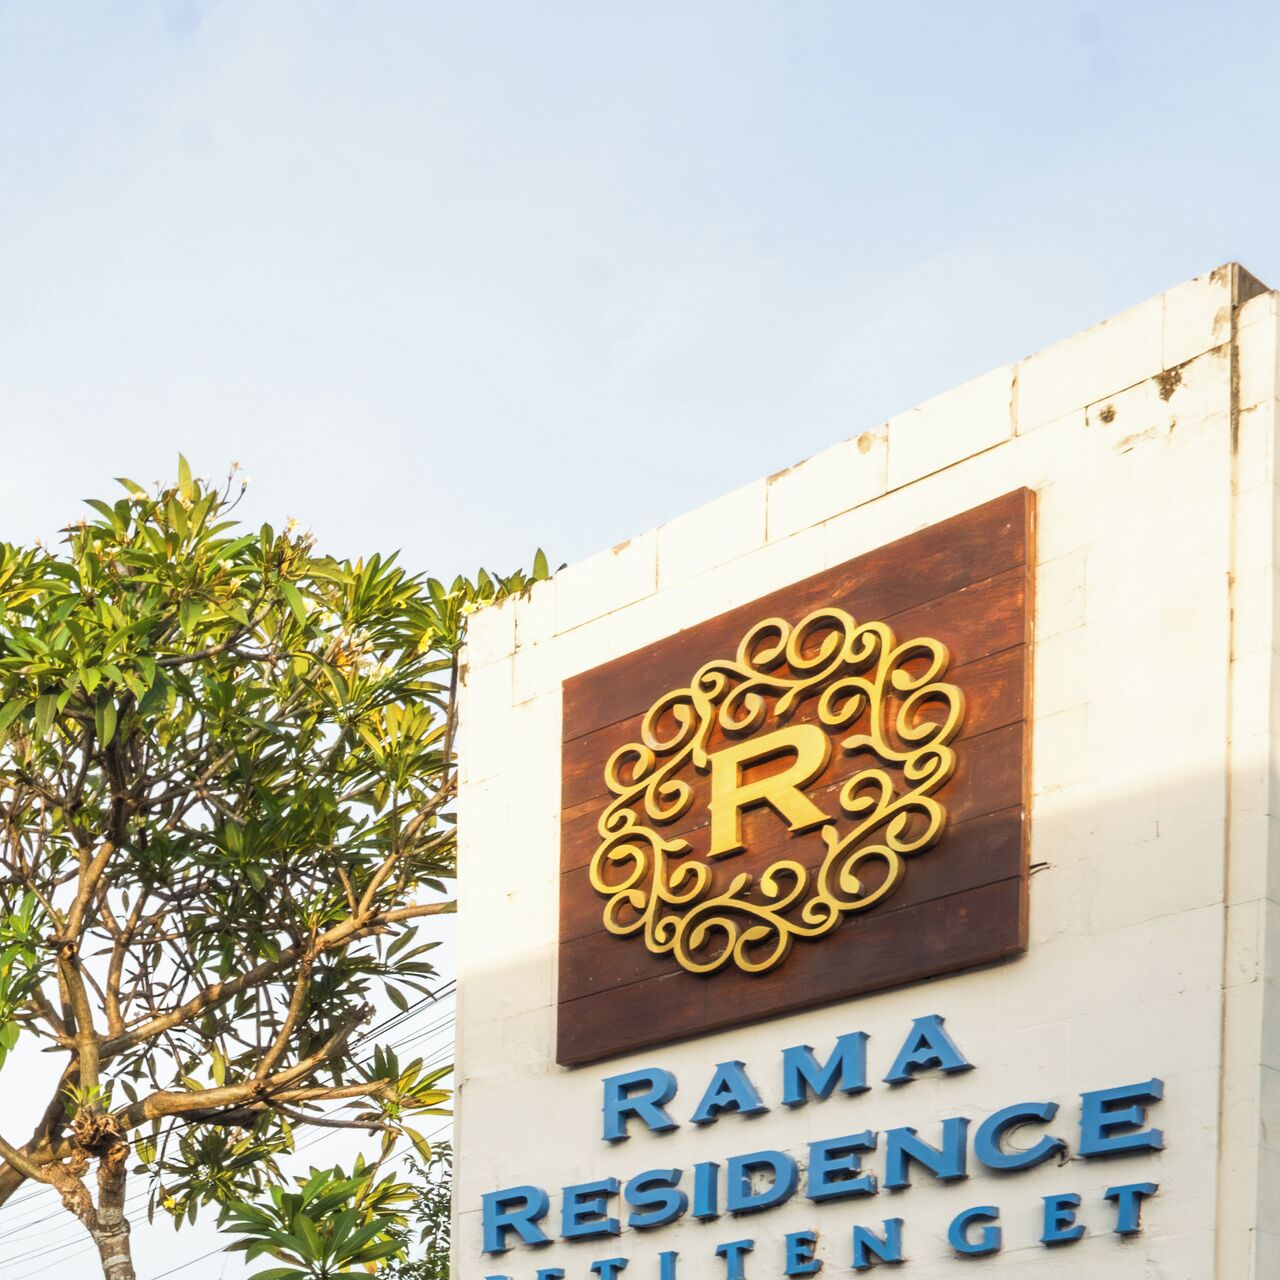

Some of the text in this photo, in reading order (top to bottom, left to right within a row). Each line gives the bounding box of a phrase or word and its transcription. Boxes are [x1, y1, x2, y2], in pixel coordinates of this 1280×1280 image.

[707, 723, 837, 859] R
[603, 1014, 976, 1142] RAMA
[481, 1078, 1166, 1254] RESIDENCE
